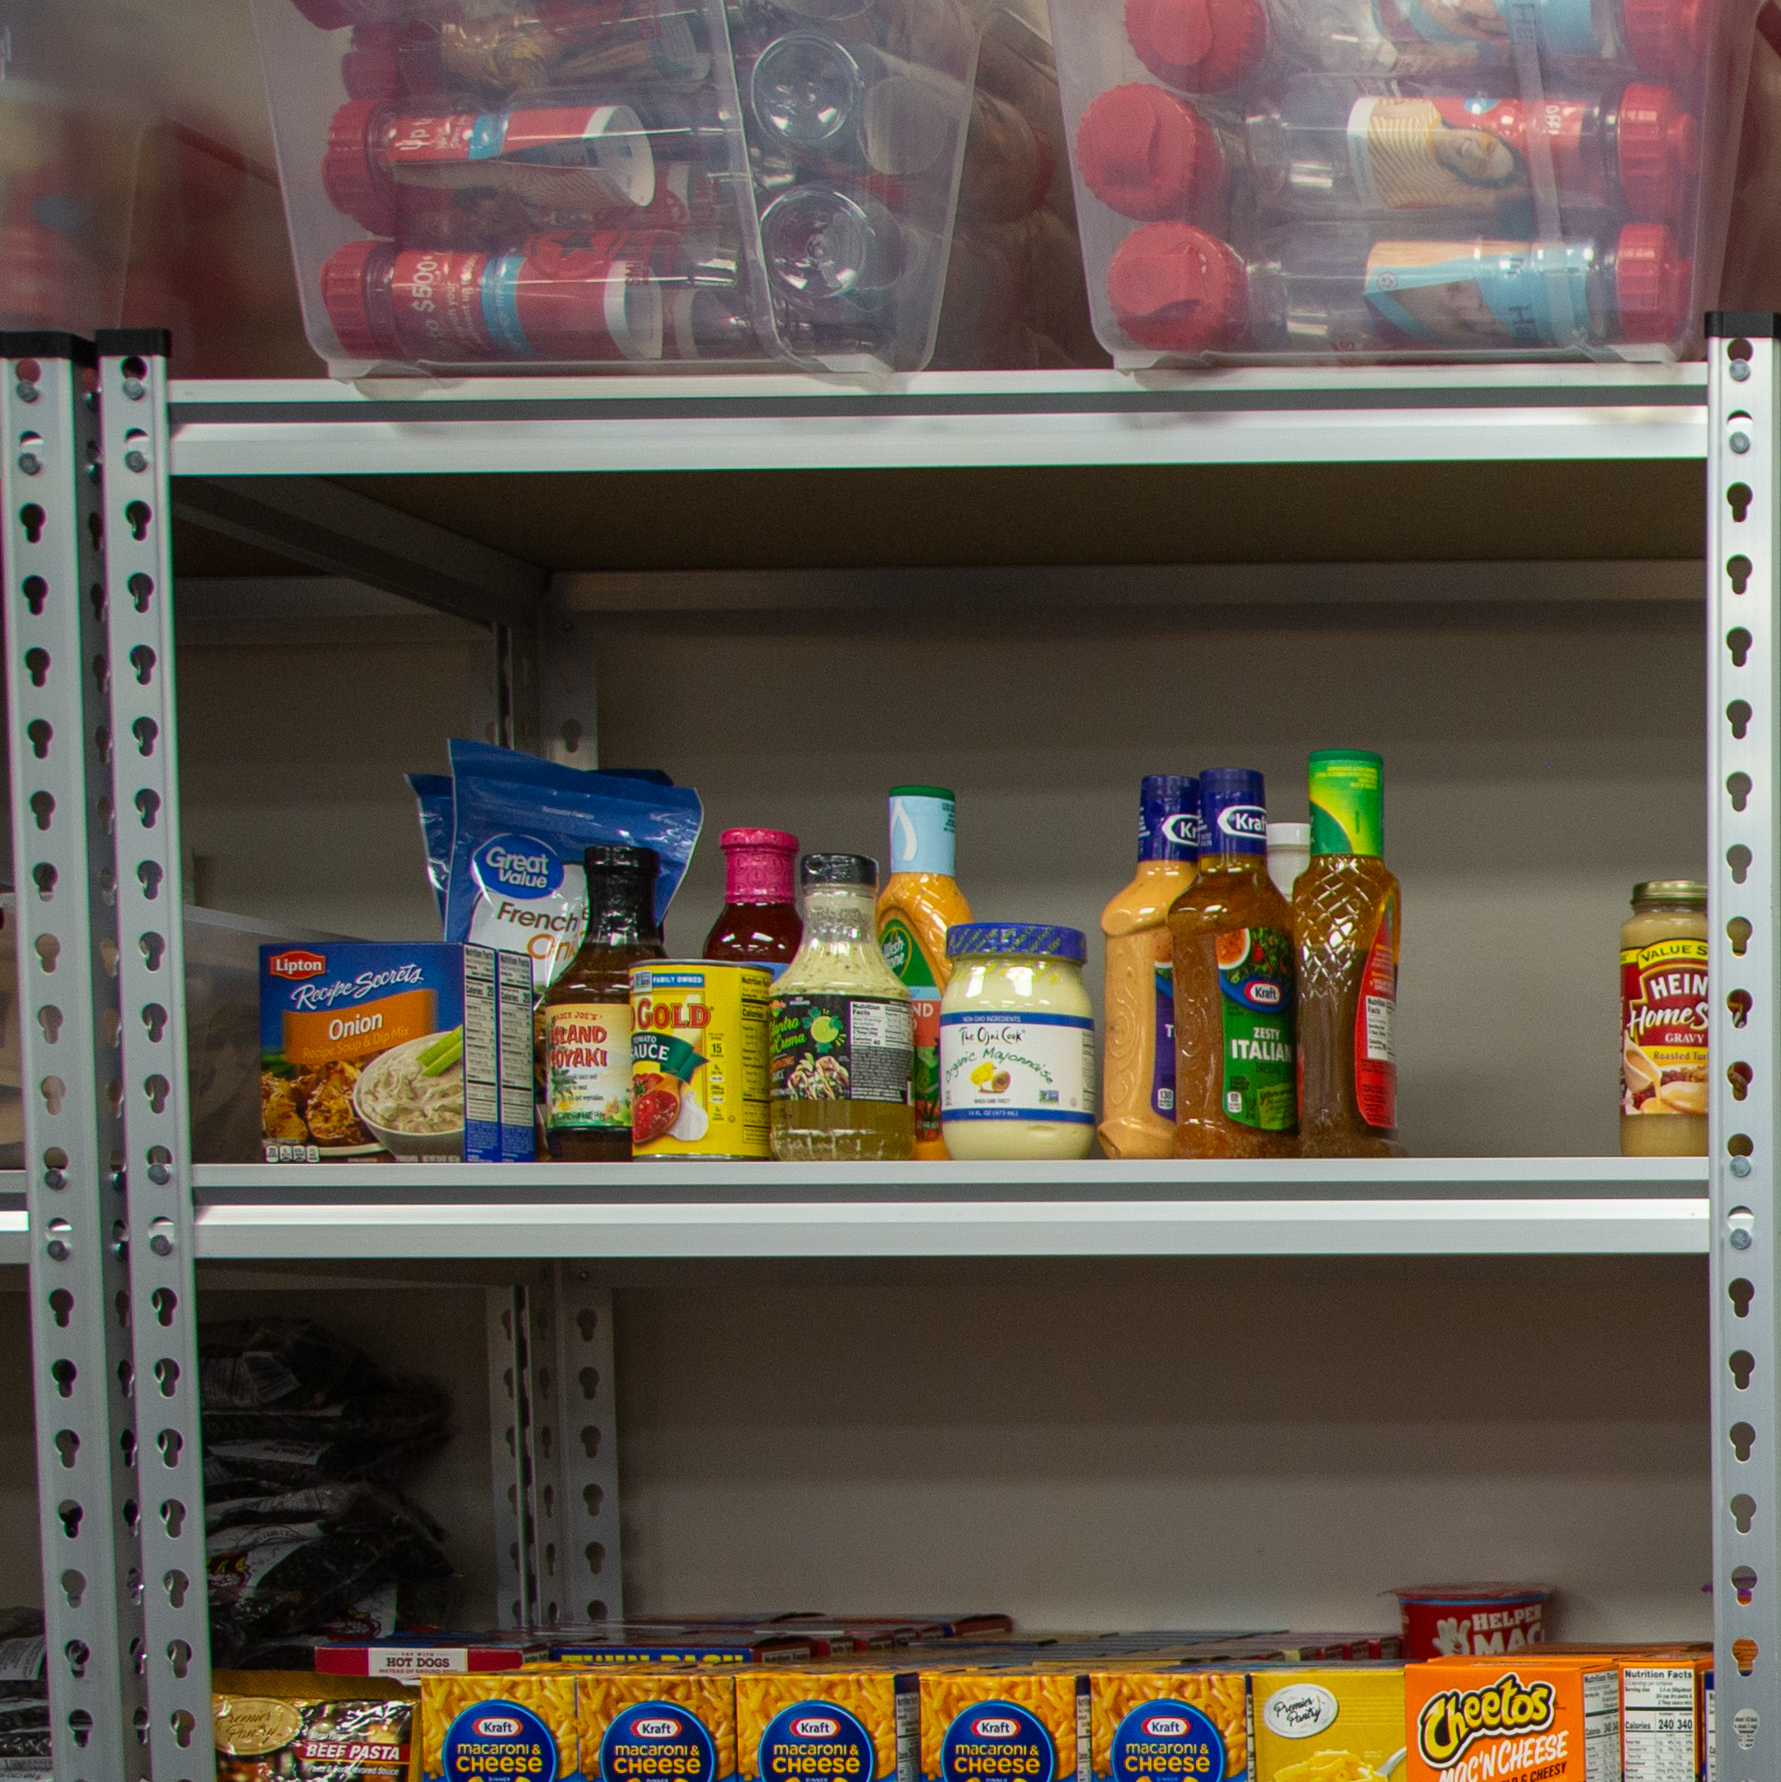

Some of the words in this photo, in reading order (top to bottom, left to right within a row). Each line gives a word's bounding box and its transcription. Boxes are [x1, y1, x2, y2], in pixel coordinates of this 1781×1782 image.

[485, 846, 549, 875] Great
[498, 868, 548, 889] Value
[497, 901, 578, 932] French
[275, 958, 322, 972] Lipton
[652, 974, 680, 985] FAMILY
[681, 973, 704, 984] OWNED
[291, 977, 356, 1011] Recipe
[352, 964, 424, 996] Secrets
[1254, 985, 1278, 999] Kraft
[328, 1012, 383, 1042] Onion
[1254, 1026, 1280, 1040] ZESTY
[1664, 1032, 1705, 1044] GRAVY
[1231, 1039, 1293, 1062] ITALIAN
[386, 1656, 417, 1668] HOT
[420, 1656, 450, 1668] DOGS
[1625, 1670, 1665, 1680] Nutrition
[1668, 1671, 1692, 1680] Facts
[483, 1721, 513, 1734] Kraft
[1420, 1673, 1555, 1768] Cheetos
[457, 1743, 530, 1755] macaroni
[531, 1745, 541, 1755] &
